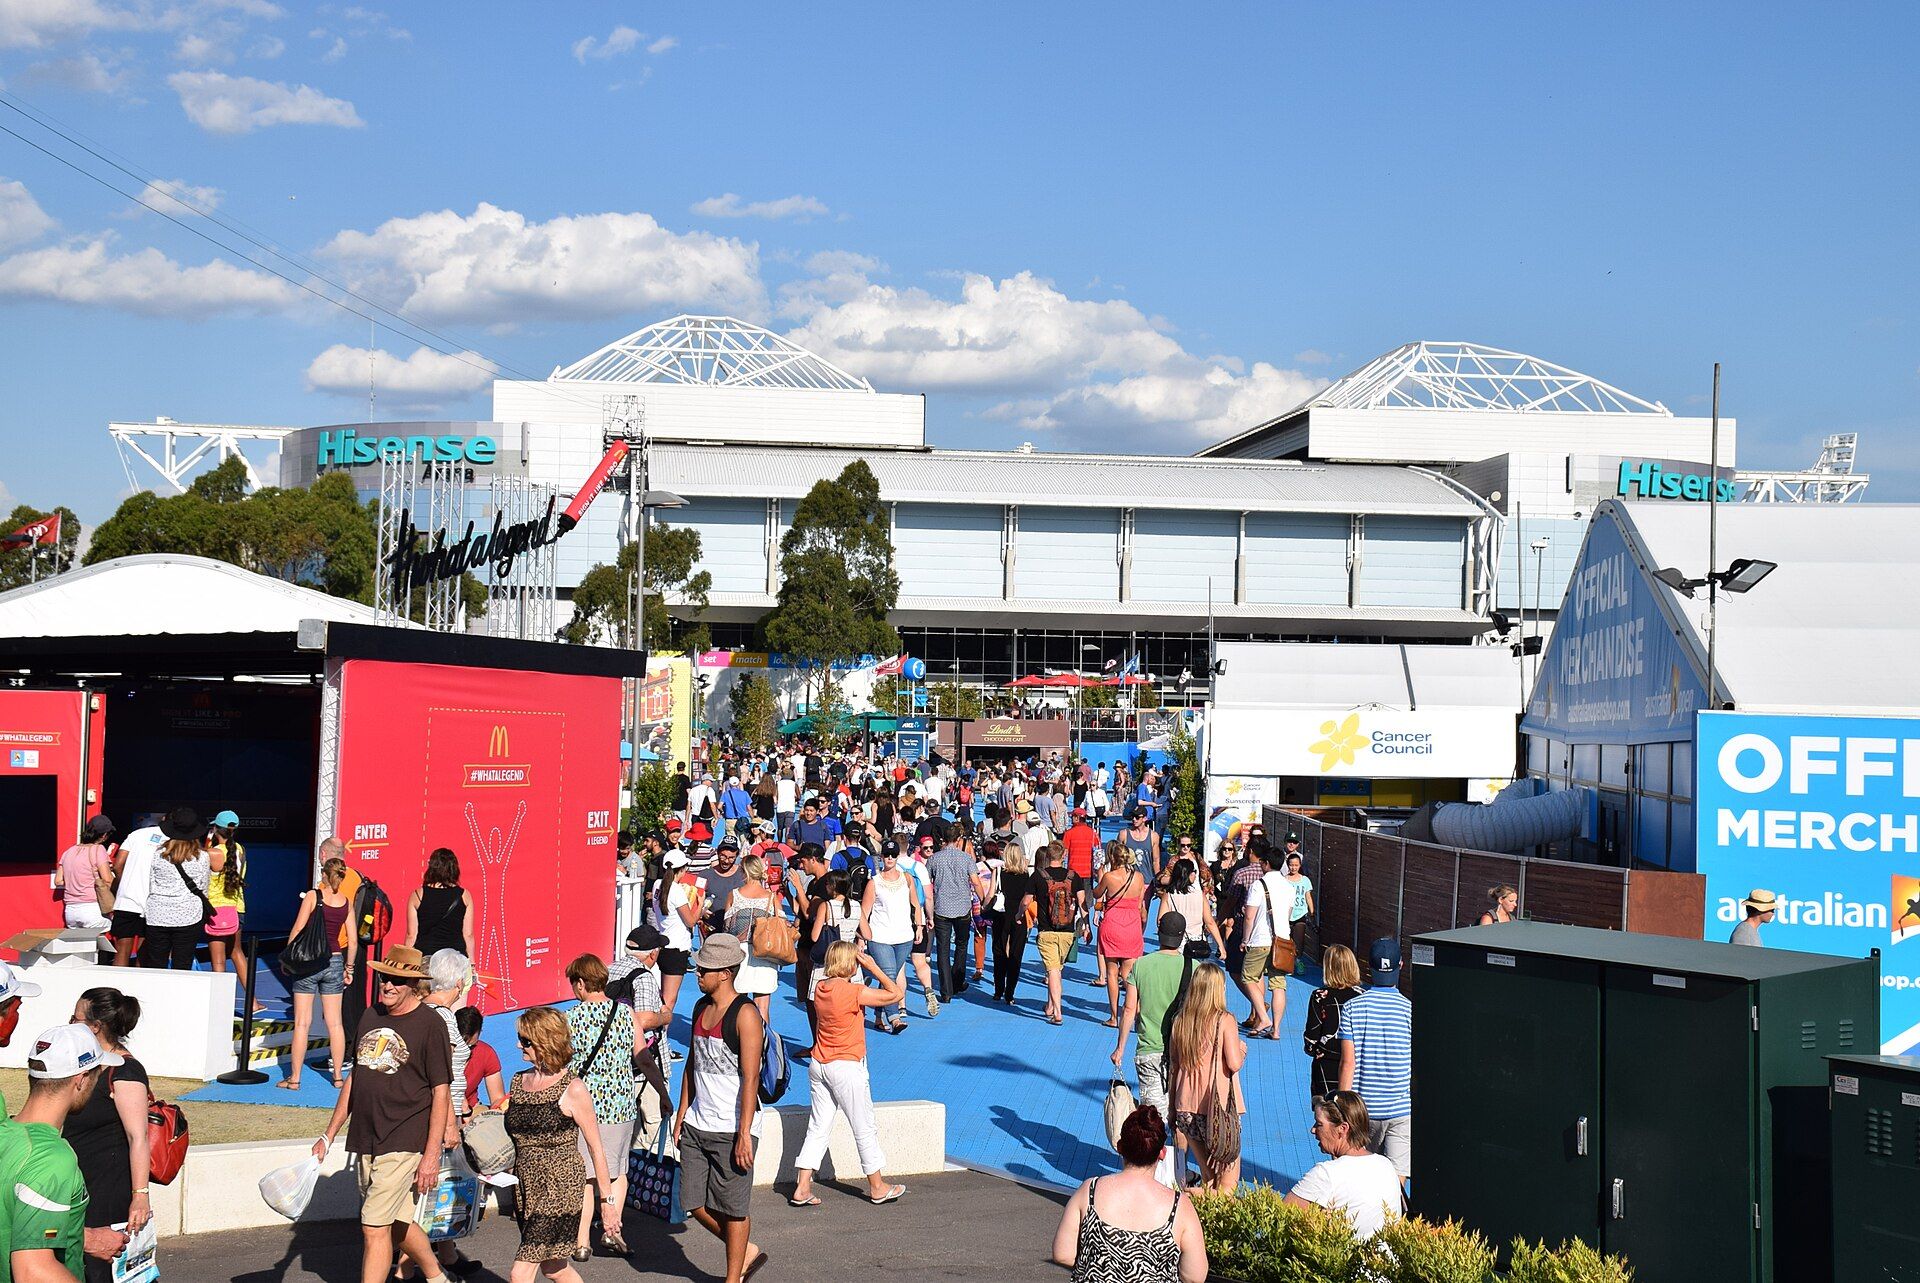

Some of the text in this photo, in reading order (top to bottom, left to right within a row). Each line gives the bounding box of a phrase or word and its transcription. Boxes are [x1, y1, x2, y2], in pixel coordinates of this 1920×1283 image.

[317, 429, 497, 466] Hisense
[1617, 460, 1736, 502] Hisense
[1575, 552, 1629, 622] OFFICIAL
[703, 656, 763, 664] set match
[1560, 617, 1646, 687] MERCHANDISE
[987, 724, 1014, 734] Lindt
[1371, 730, 1432, 742] Cancer
[1371, 743, 1433, 755] Council
[1717, 733, 1920, 798] OFFI
[470, 769, 524, 782] #WHATALEGEND
[587, 810, 609, 829] EXIT
[354, 824, 388, 840] ENTER
[1717, 808, 1918, 853] MERCH
[591, 836, 609, 846] LEGEND
[361, 849, 380, 860] HERE
